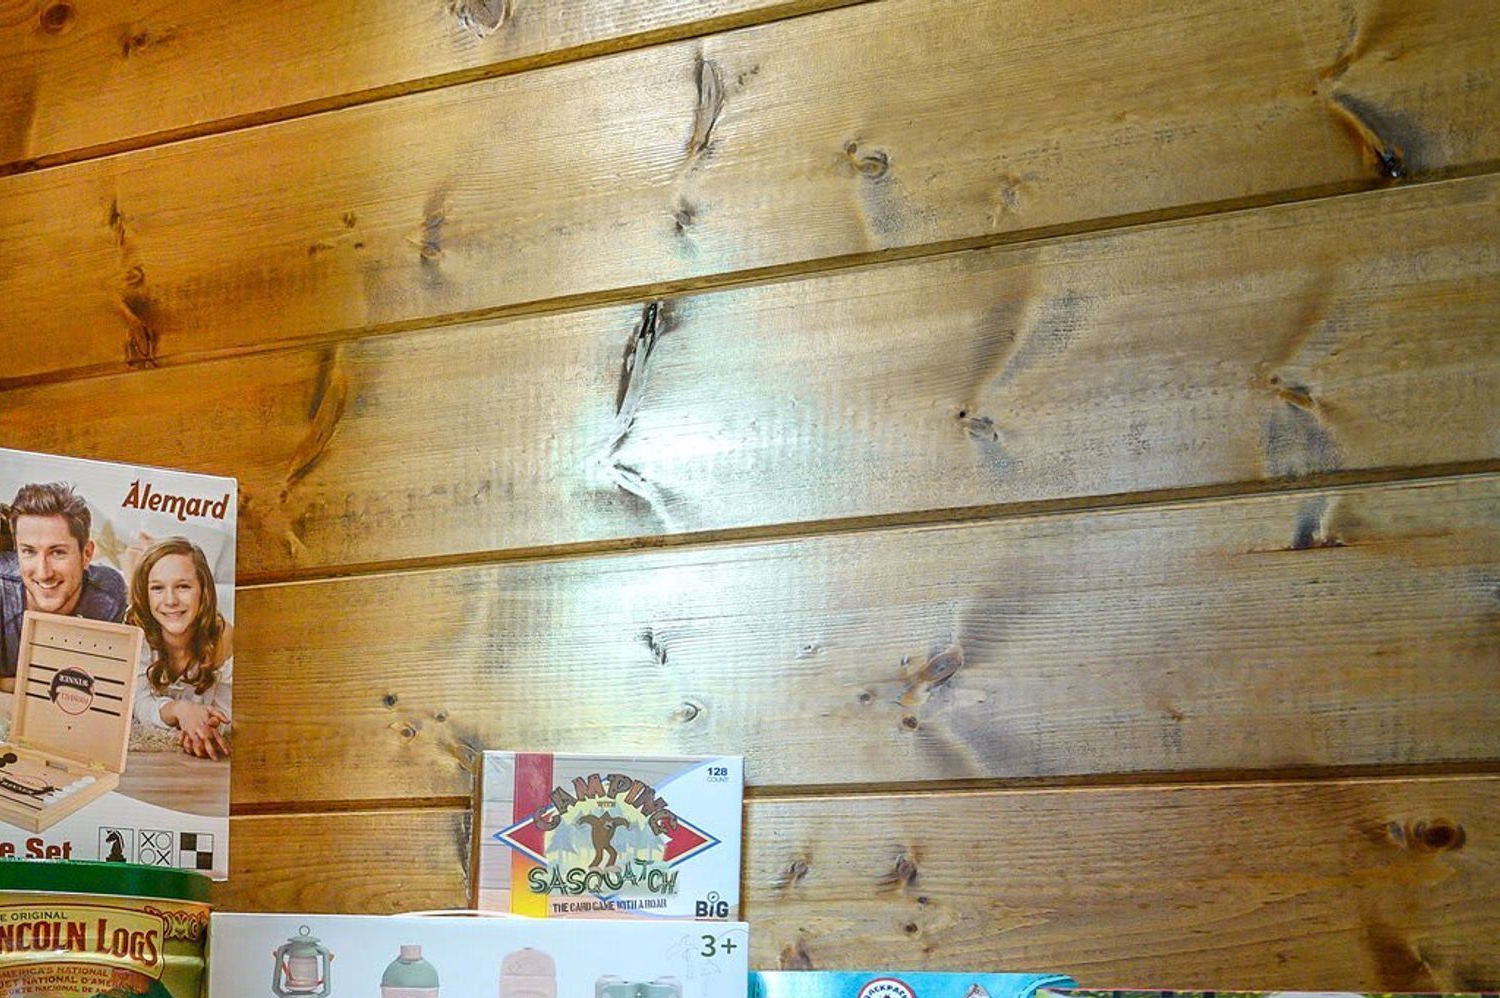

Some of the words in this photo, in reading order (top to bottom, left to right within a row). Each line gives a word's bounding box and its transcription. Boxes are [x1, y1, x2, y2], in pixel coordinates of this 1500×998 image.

[706, 767, 729, 777] 128
[533, 773, 678, 837] CAMPING
[25, 837, 72, 862] Set
[527, 858, 678, 896] SASQUATCH
[553, 902, 569, 913] THE
[570, 901, 592, 912] CARD
[592, 900, 615, 911] GAME
[11, 911, 68, 921] ORIGINAL
[97, 918, 158, 967] LOGS
[700, 934, 738, 958] 3+
[57, 966, 109, 977] NATIONAL
[23, 976, 78, 986] NATIONAL
[35, 985, 79, 994] NACIONAL
